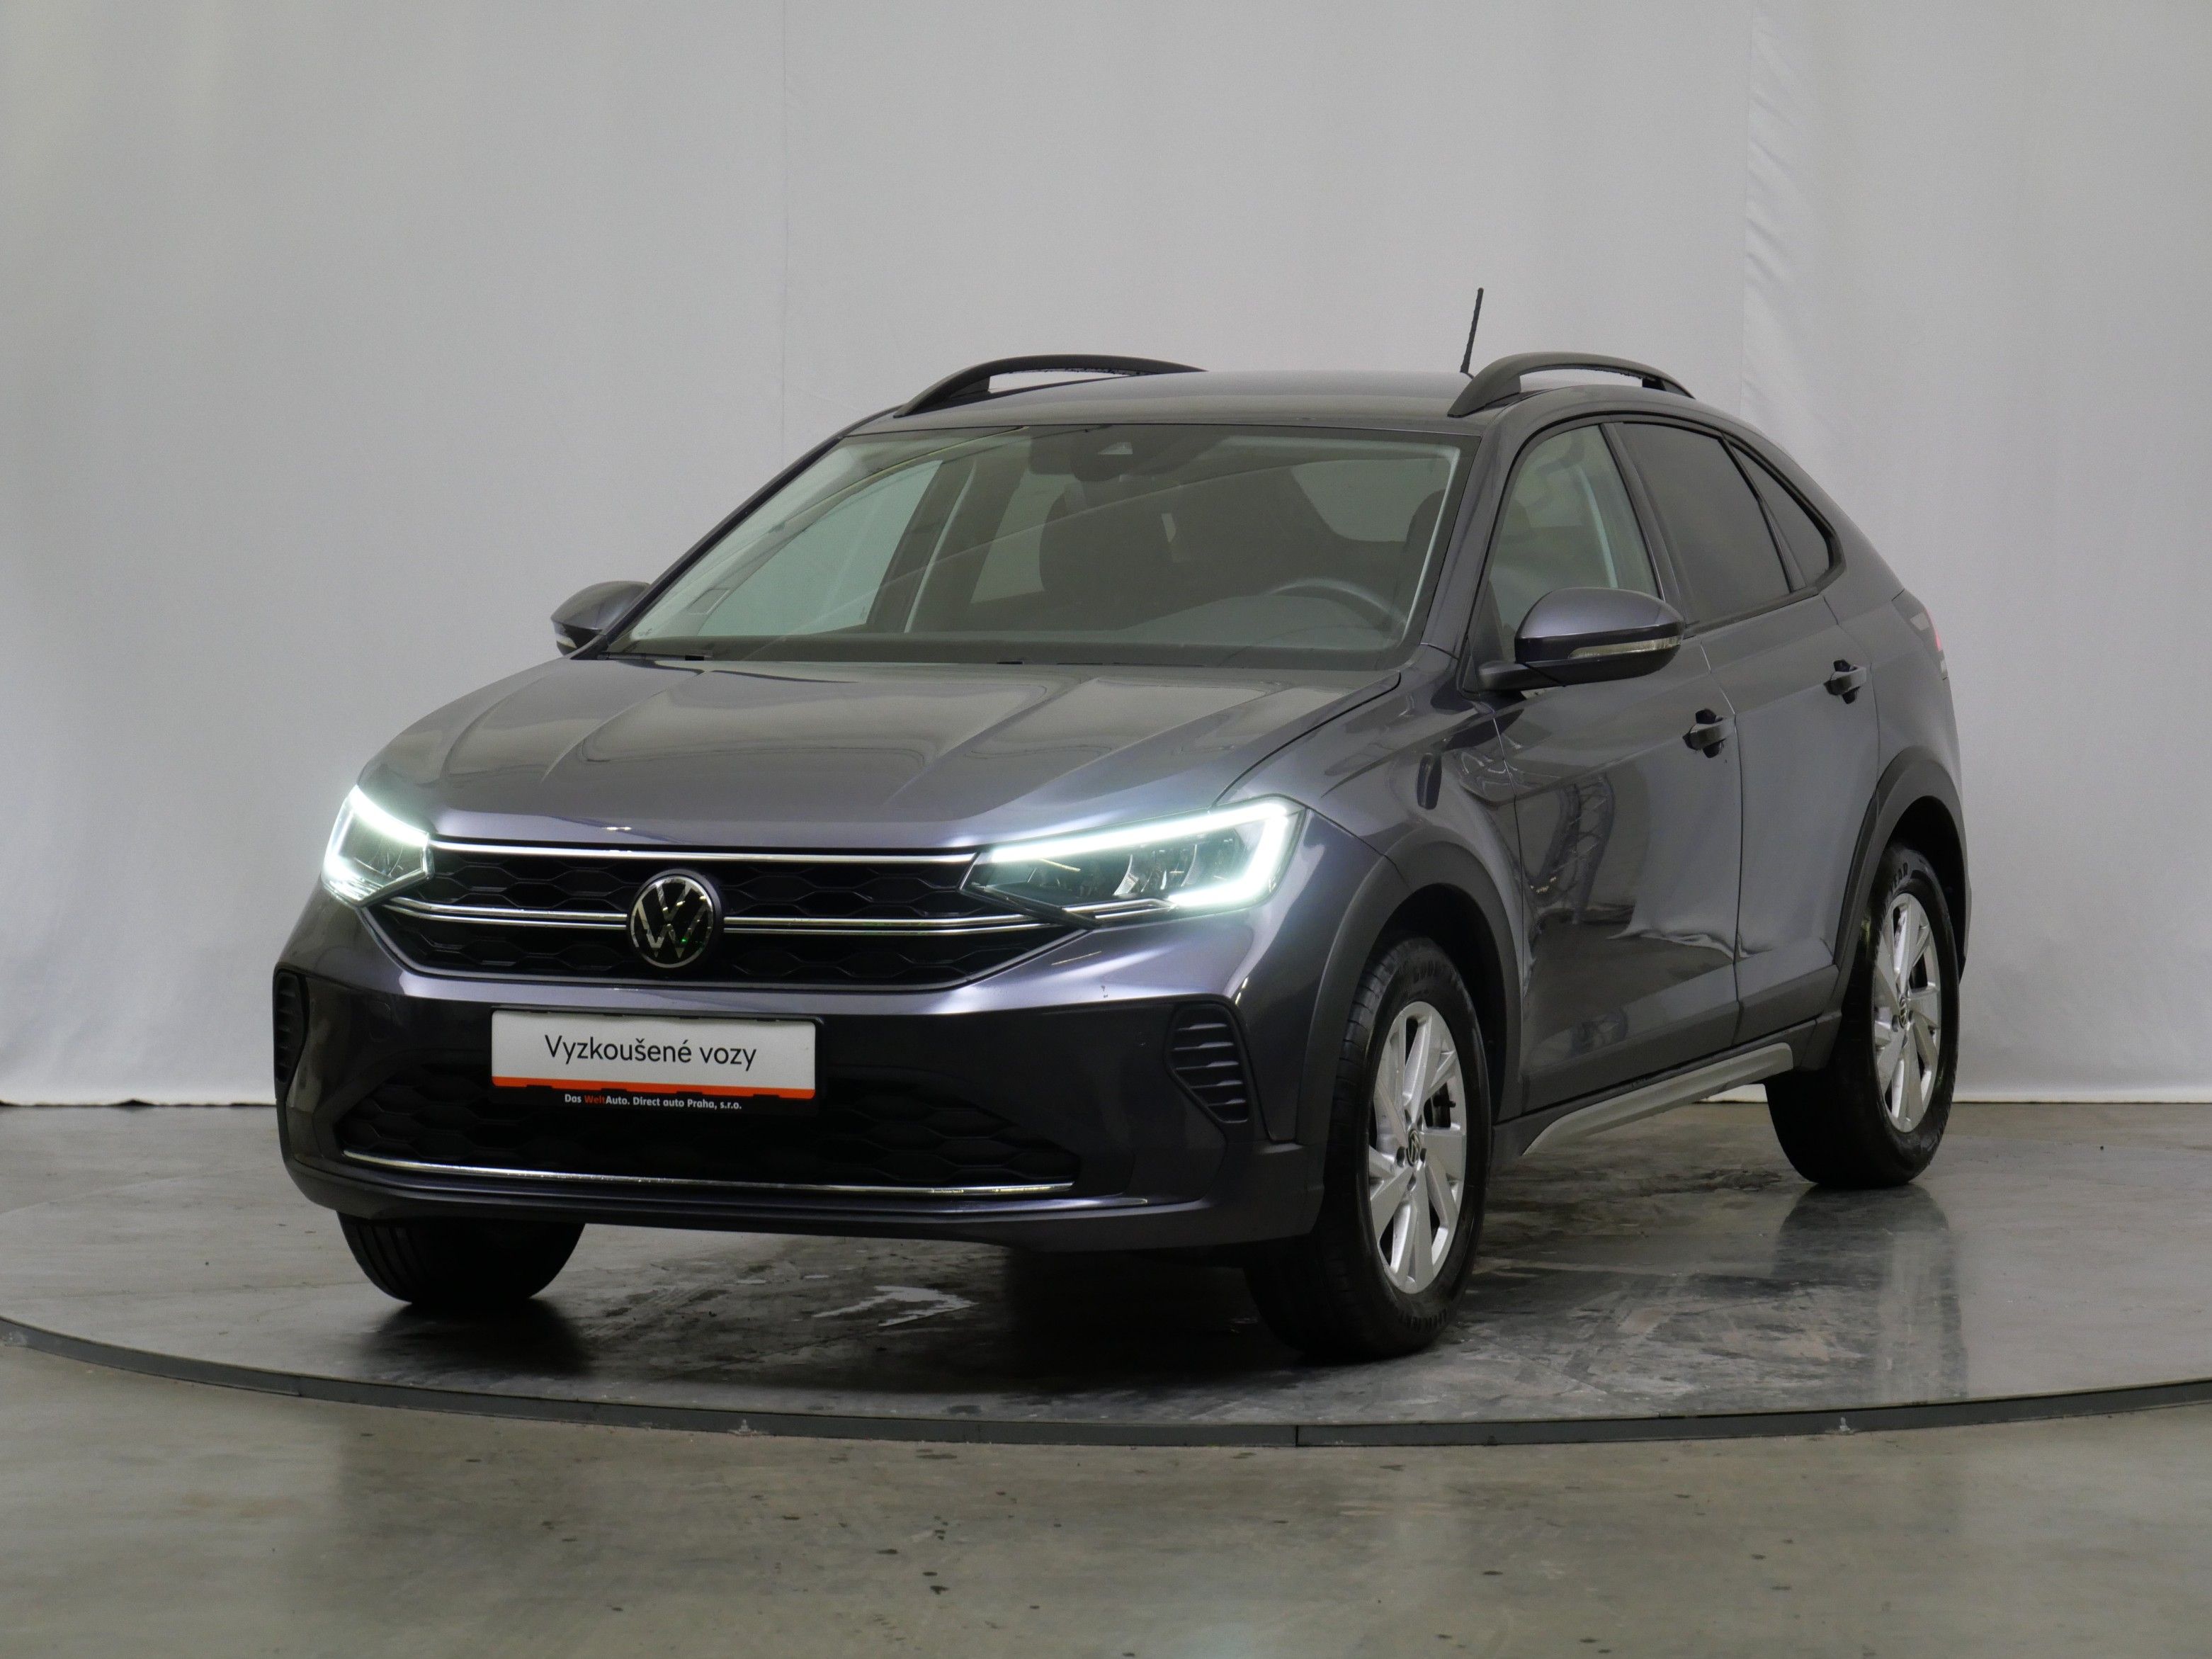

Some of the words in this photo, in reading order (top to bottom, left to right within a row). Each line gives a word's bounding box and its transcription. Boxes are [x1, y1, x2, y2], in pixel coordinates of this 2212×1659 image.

[632, 877, 713, 966] VW
[544, 1034, 693, 1065] Vyzkoušené
[699, 1046, 757, 1071] vozy
[564, 1093, 582, 1104] Das
[633, 1096, 661, 1106] Direct
[663, 1097, 685, 1108] auto
[687, 1099, 718, 1110] Praha,
[720, 1101, 742, 1110] s.r.o.
